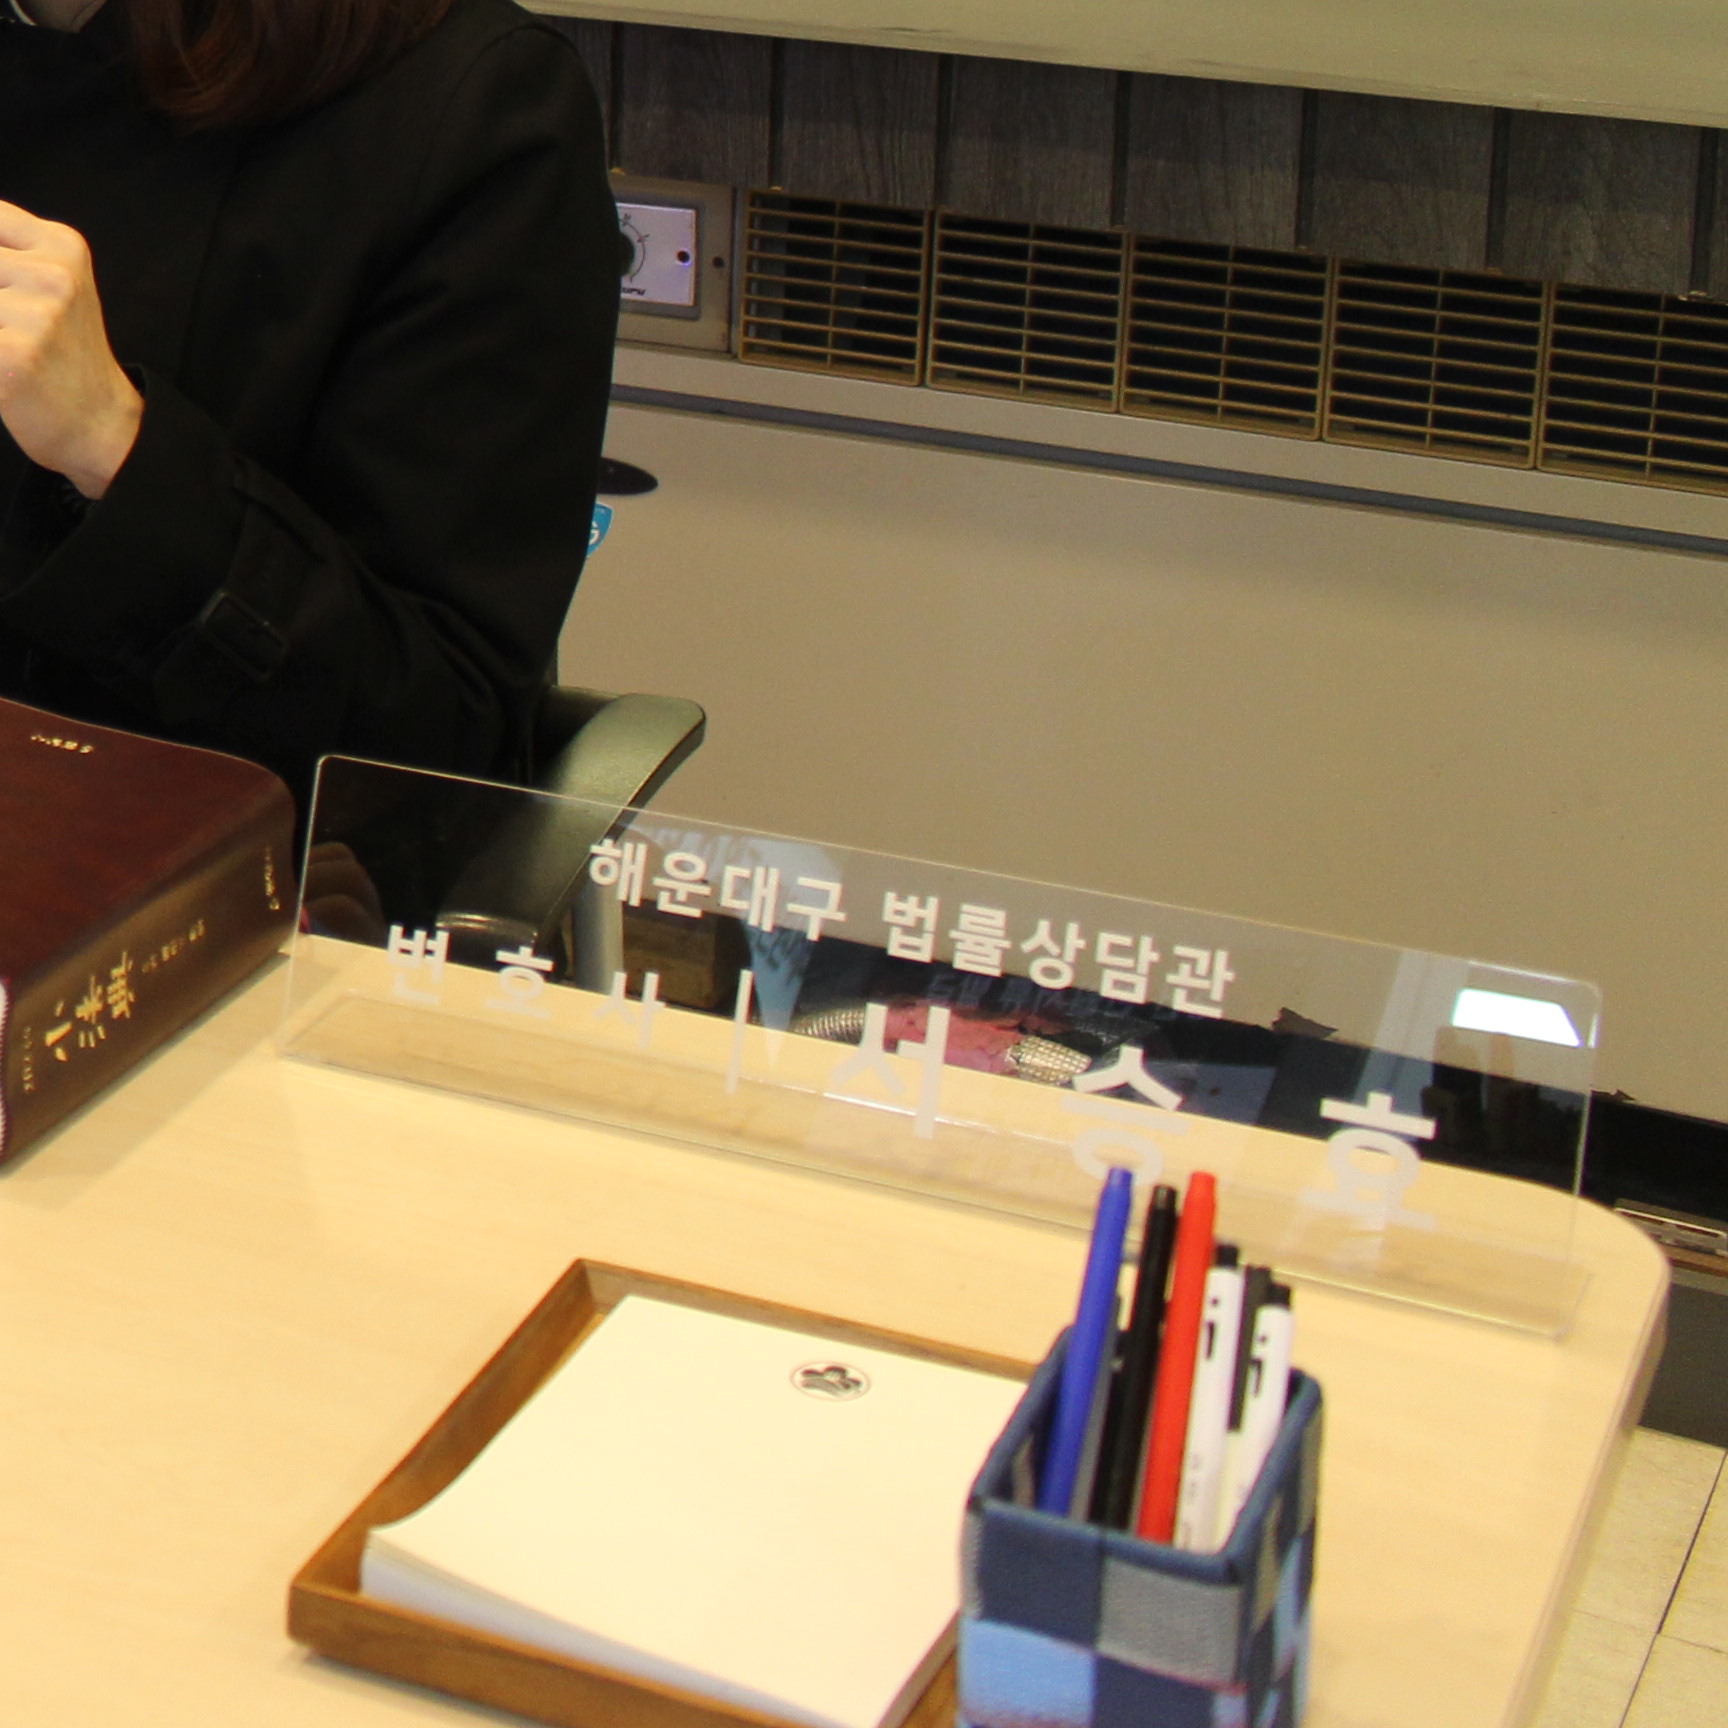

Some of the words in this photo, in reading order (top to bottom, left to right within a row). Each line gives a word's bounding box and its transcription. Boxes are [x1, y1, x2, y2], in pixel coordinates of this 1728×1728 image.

[588, 838, 848, 943] 해운대구
[881, 890, 1237, 1020] 법률상담관
[386, 923, 450, 1007] 변
[485, 945, 556, 1021] 호
[593, 970, 666, 1052] 사
[829, 1002, 952, 1140] 서
[1057, 1046, 1192, 1186] 승
